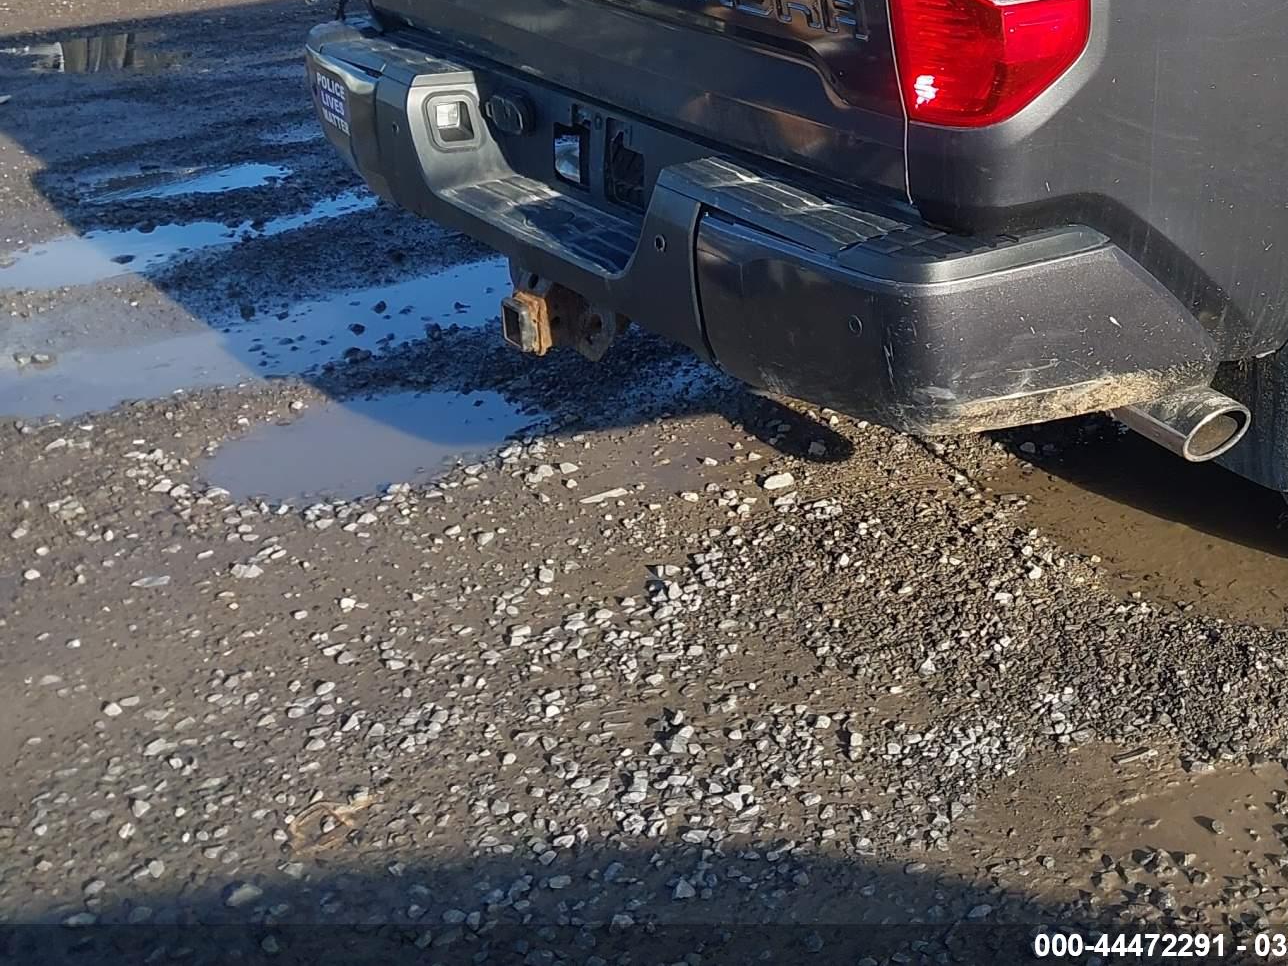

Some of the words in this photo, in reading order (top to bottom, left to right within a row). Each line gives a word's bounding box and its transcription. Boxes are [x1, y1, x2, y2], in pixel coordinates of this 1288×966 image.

[316, 71, 346, 102] POLICE
[320, 90, 345, 116] LIVES
[322, 107, 351, 137] MATTER
